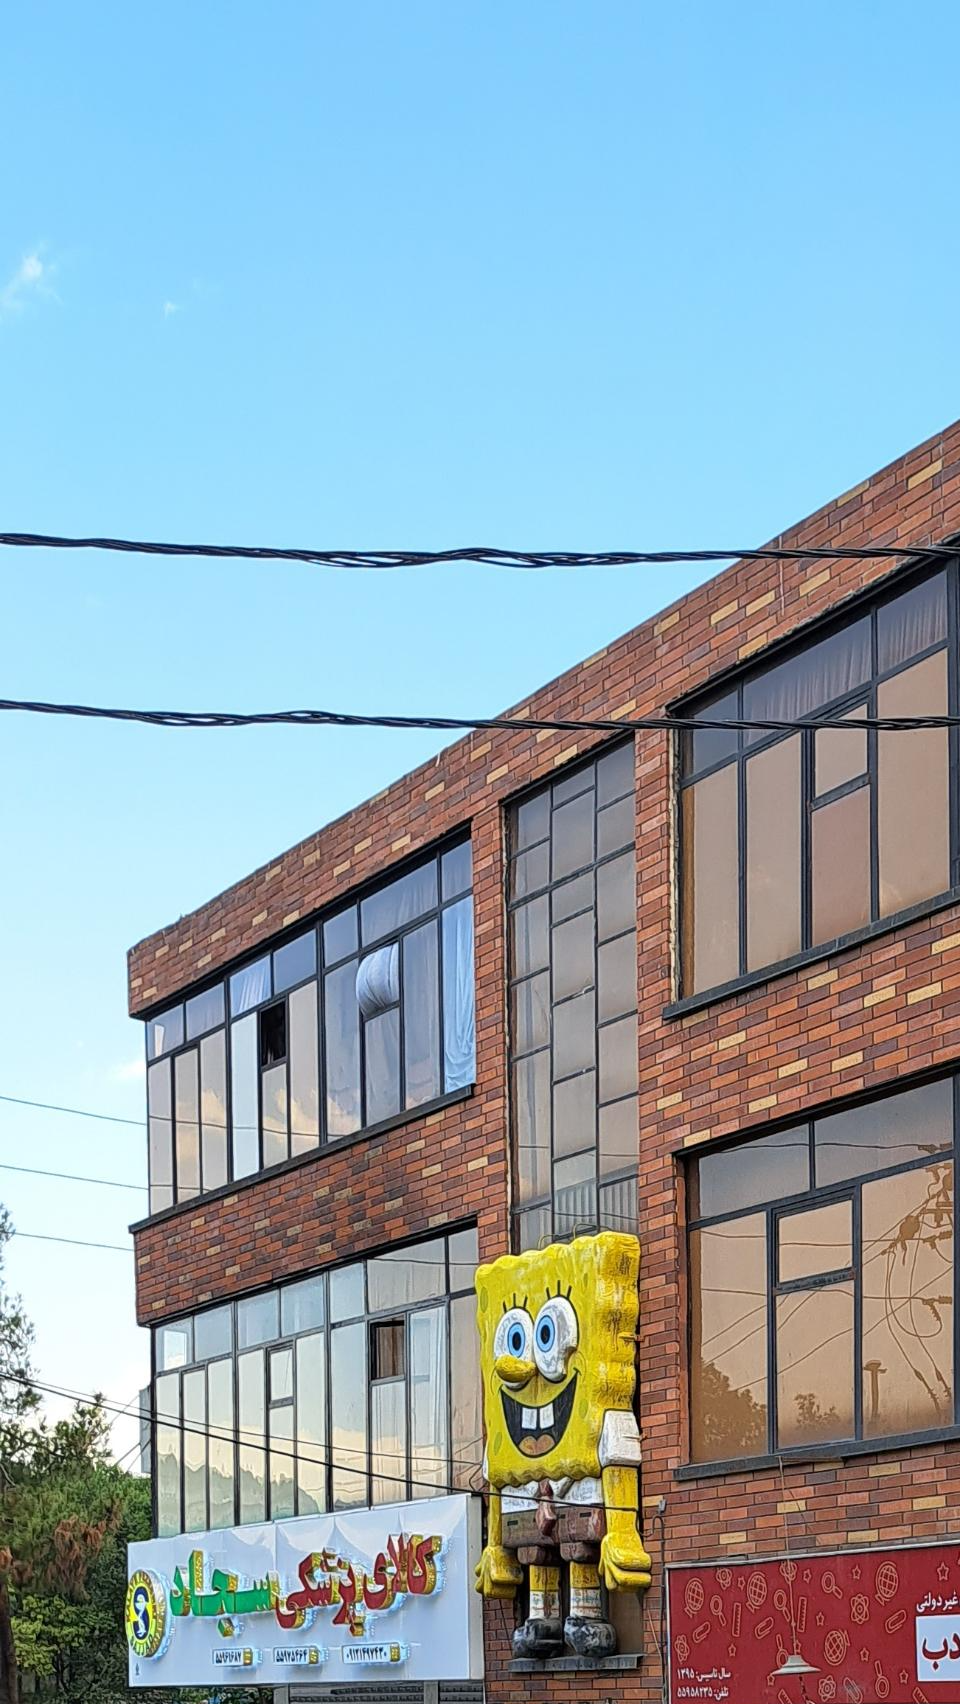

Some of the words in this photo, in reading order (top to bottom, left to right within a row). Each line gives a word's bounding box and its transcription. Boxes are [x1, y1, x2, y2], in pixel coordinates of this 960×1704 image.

[362, 1533, 443, 1611] کالای
[169, 1549, 278, 1638] سجاد
[275, 1547, 366, 1637] پزشکی
[916, 1592, 943, 1613] دولتی
[942, 1591, 959, 1611] غیر
[677, 1667, 695, 1680] ۱۳۹۵
[718, 1667, 731, 1680] سال
